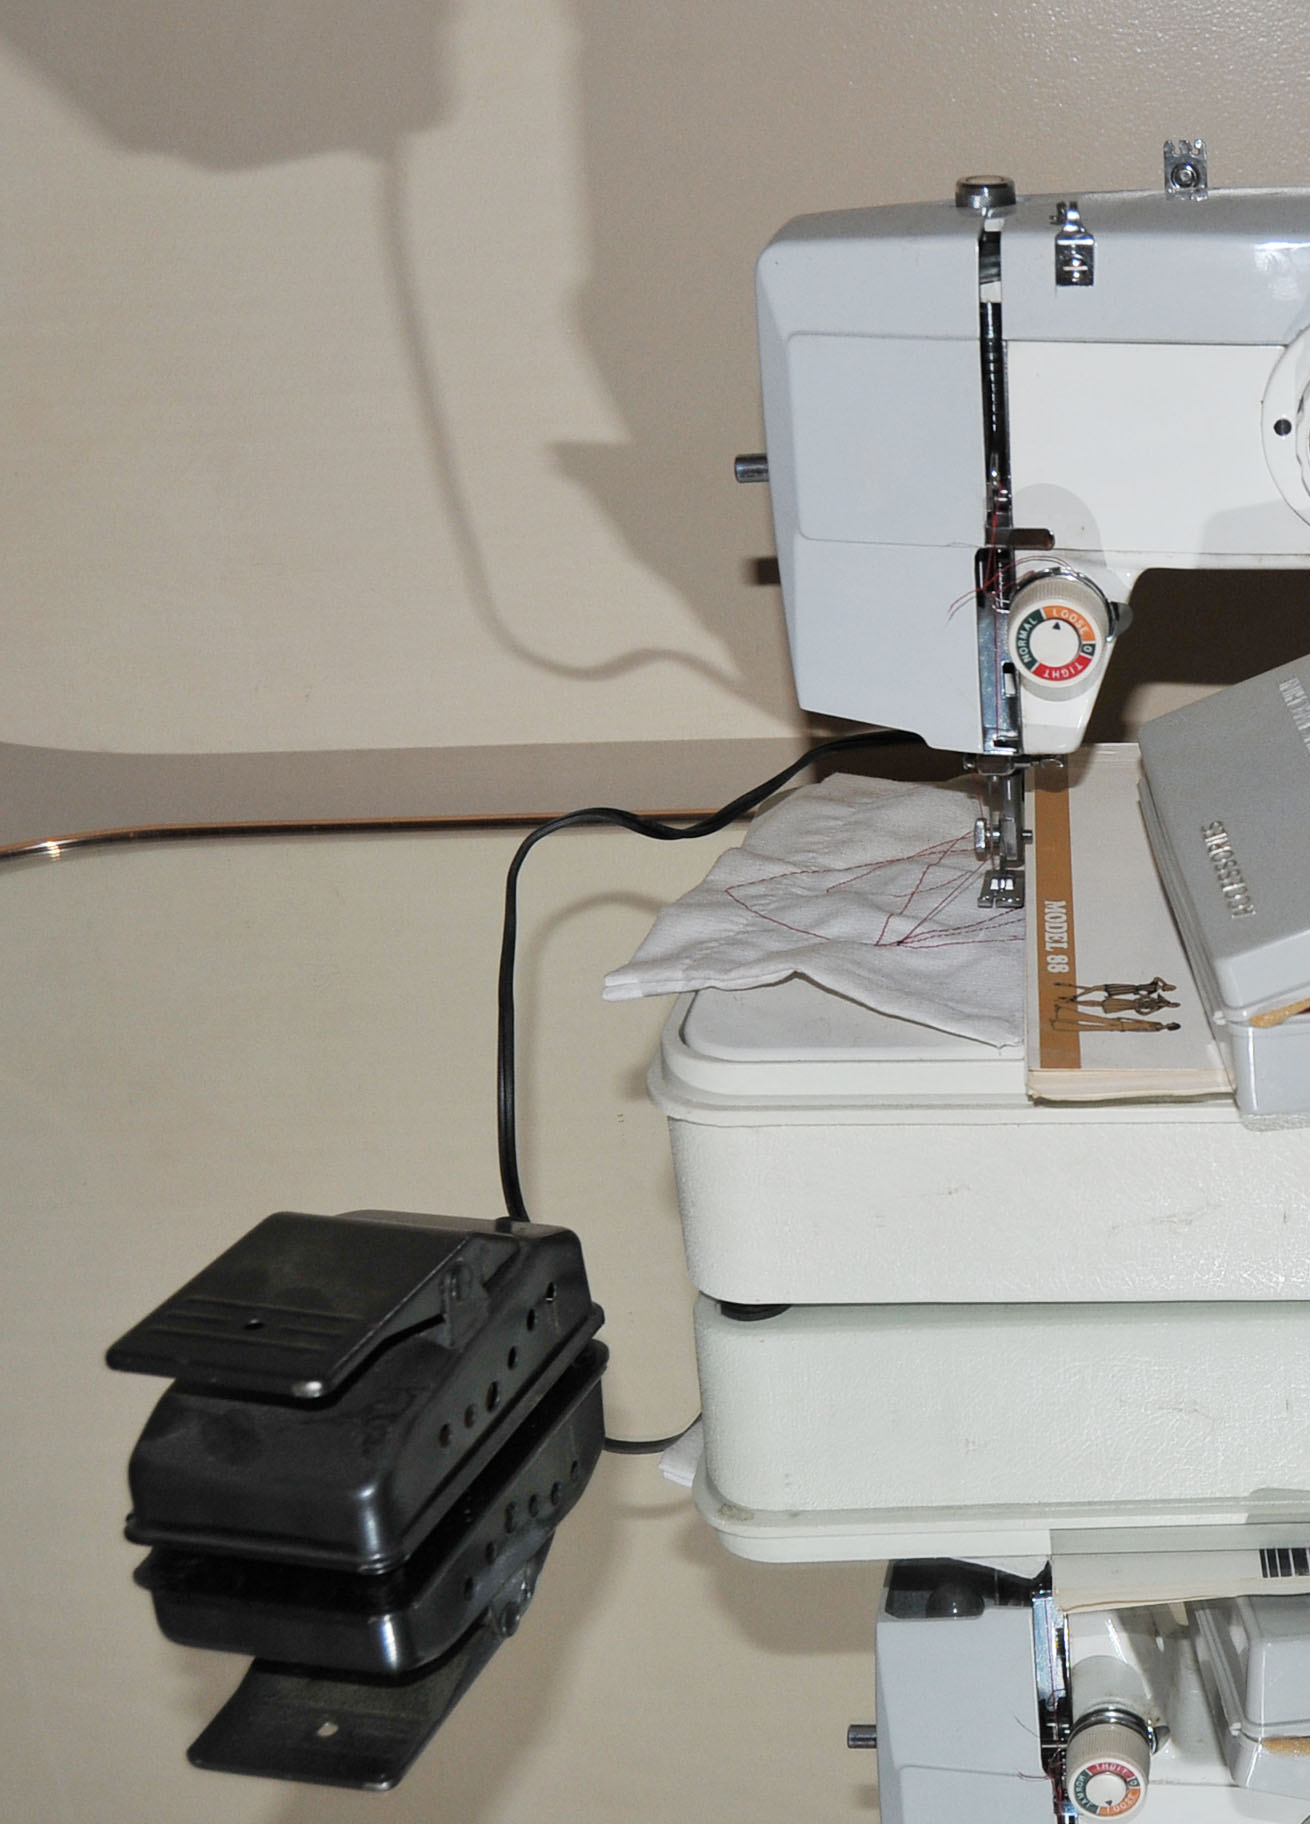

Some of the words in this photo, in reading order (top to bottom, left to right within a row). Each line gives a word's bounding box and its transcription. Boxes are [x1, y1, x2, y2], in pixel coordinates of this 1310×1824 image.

[1017, 617, 1038, 663] NORMAL
[1053, 608, 1091, 637] LOOSE
[1043, 661, 1084, 679] TIGHT
[1201, 819, 1256, 919] ACCESSORIES
[1044, 900, 1069, 952] MODEL
[1046, 955, 1070, 974] 88
